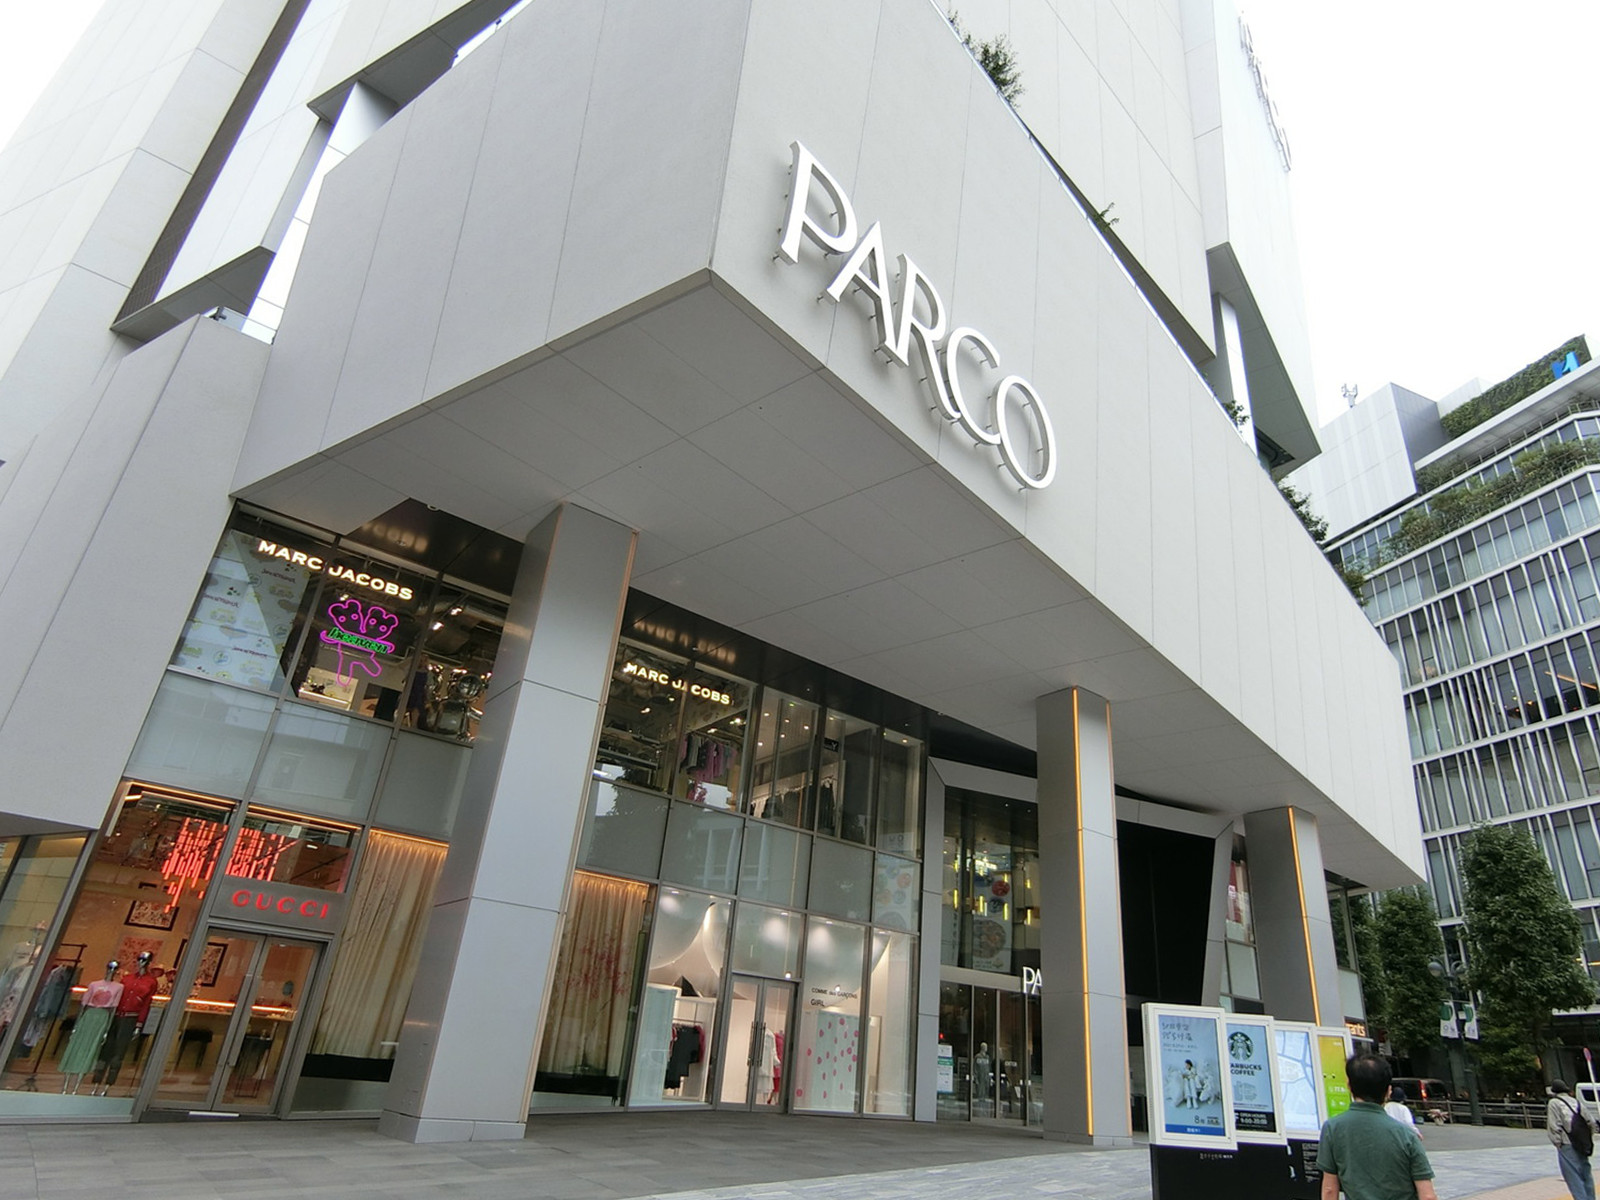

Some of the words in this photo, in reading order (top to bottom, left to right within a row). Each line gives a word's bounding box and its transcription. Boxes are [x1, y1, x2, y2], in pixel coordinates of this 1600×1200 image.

[776, 140, 1057, 490] PARCO
[258, 540, 323, 571] MARC
[328, 565, 414, 601] JACOBS
[327, 627, 390, 655] heaven
[623, 662, 669, 685] MARC
[671, 679, 730, 705] JACOBS
[232, 890, 328, 918] GUCCI
[1230, 1063, 1262, 1071] ARBUCKS
